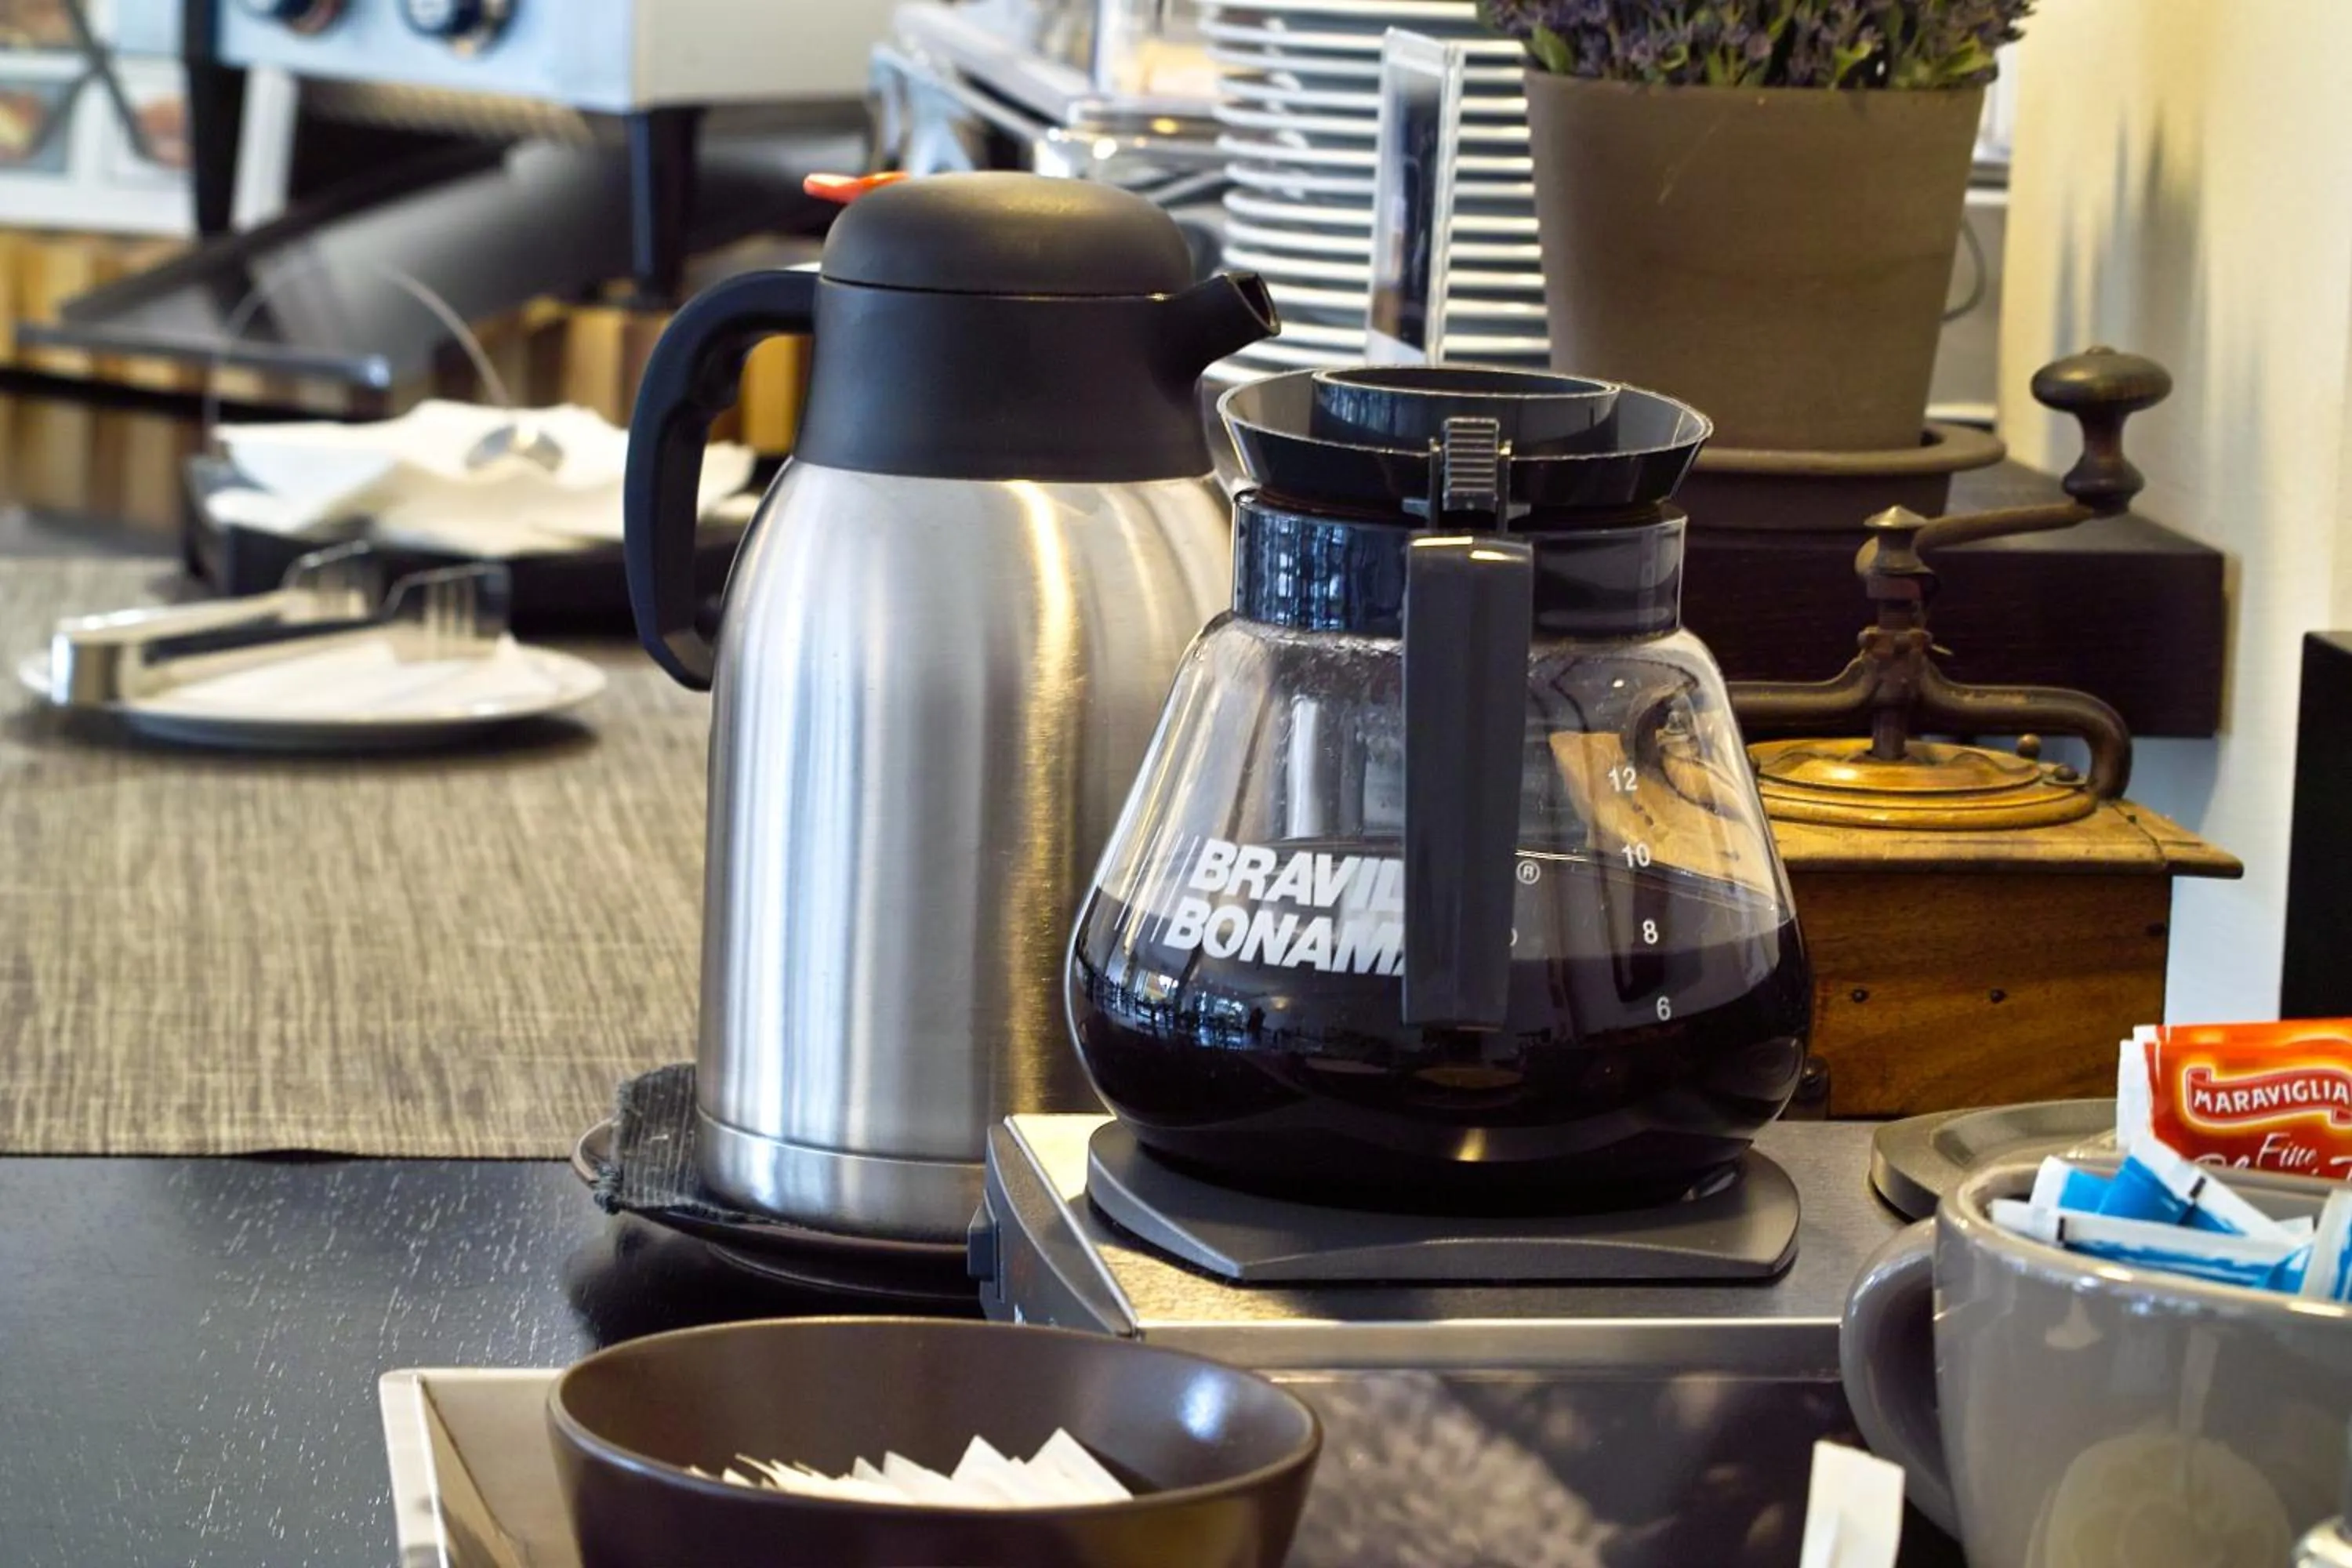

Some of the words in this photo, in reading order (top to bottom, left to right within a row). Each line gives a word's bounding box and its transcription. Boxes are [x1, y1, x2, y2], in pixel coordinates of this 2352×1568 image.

[1608, 767, 1638, 792] 12
[1621, 841, 1650, 868] 10
[1189, 837, 1406, 913] BRAVIL
[1163, 895, 1406, 976] BONAM
[1642, 919, 1658, 946] 8
[1656, 996, 1671, 1021] 6
[2193, 1078, 2350, 1114] MARAVIGLIA
[2256, 1131, 2318, 1170] Fine
